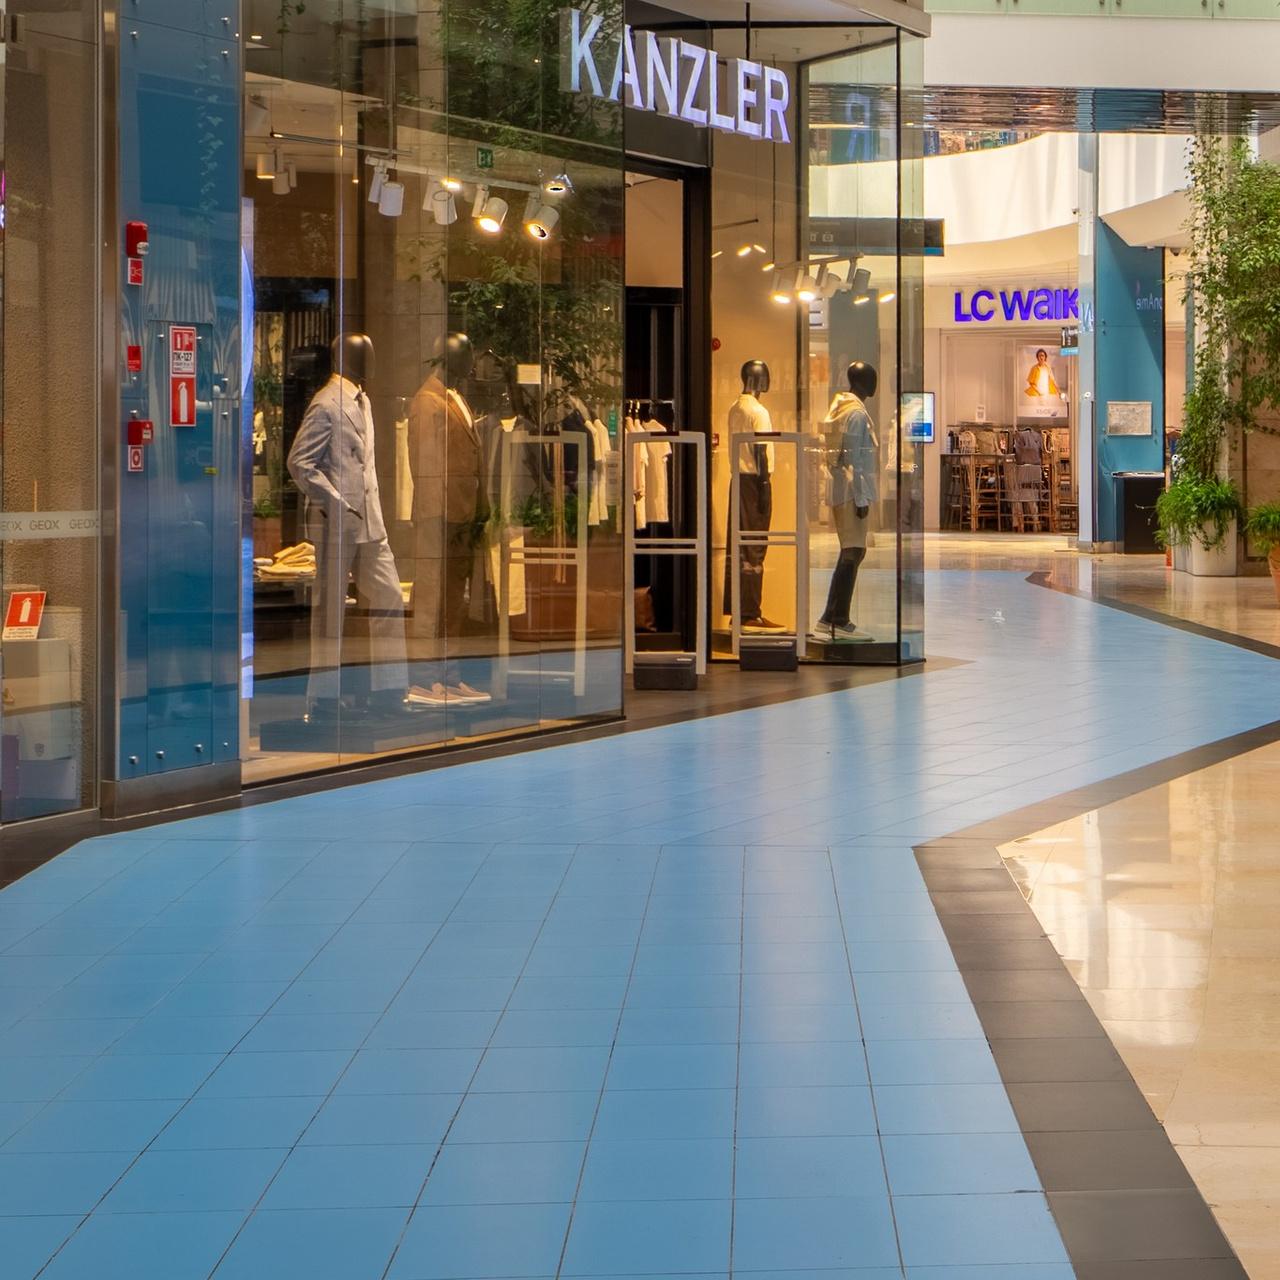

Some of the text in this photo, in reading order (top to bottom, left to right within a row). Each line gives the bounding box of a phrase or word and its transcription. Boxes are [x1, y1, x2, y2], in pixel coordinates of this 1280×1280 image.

[560, 7, 791, 144] KANZLER
[954, 290, 995, 322] LC
[29, 519, 60, 531] GEOX
[69, 518, 99, 530] GEOX
